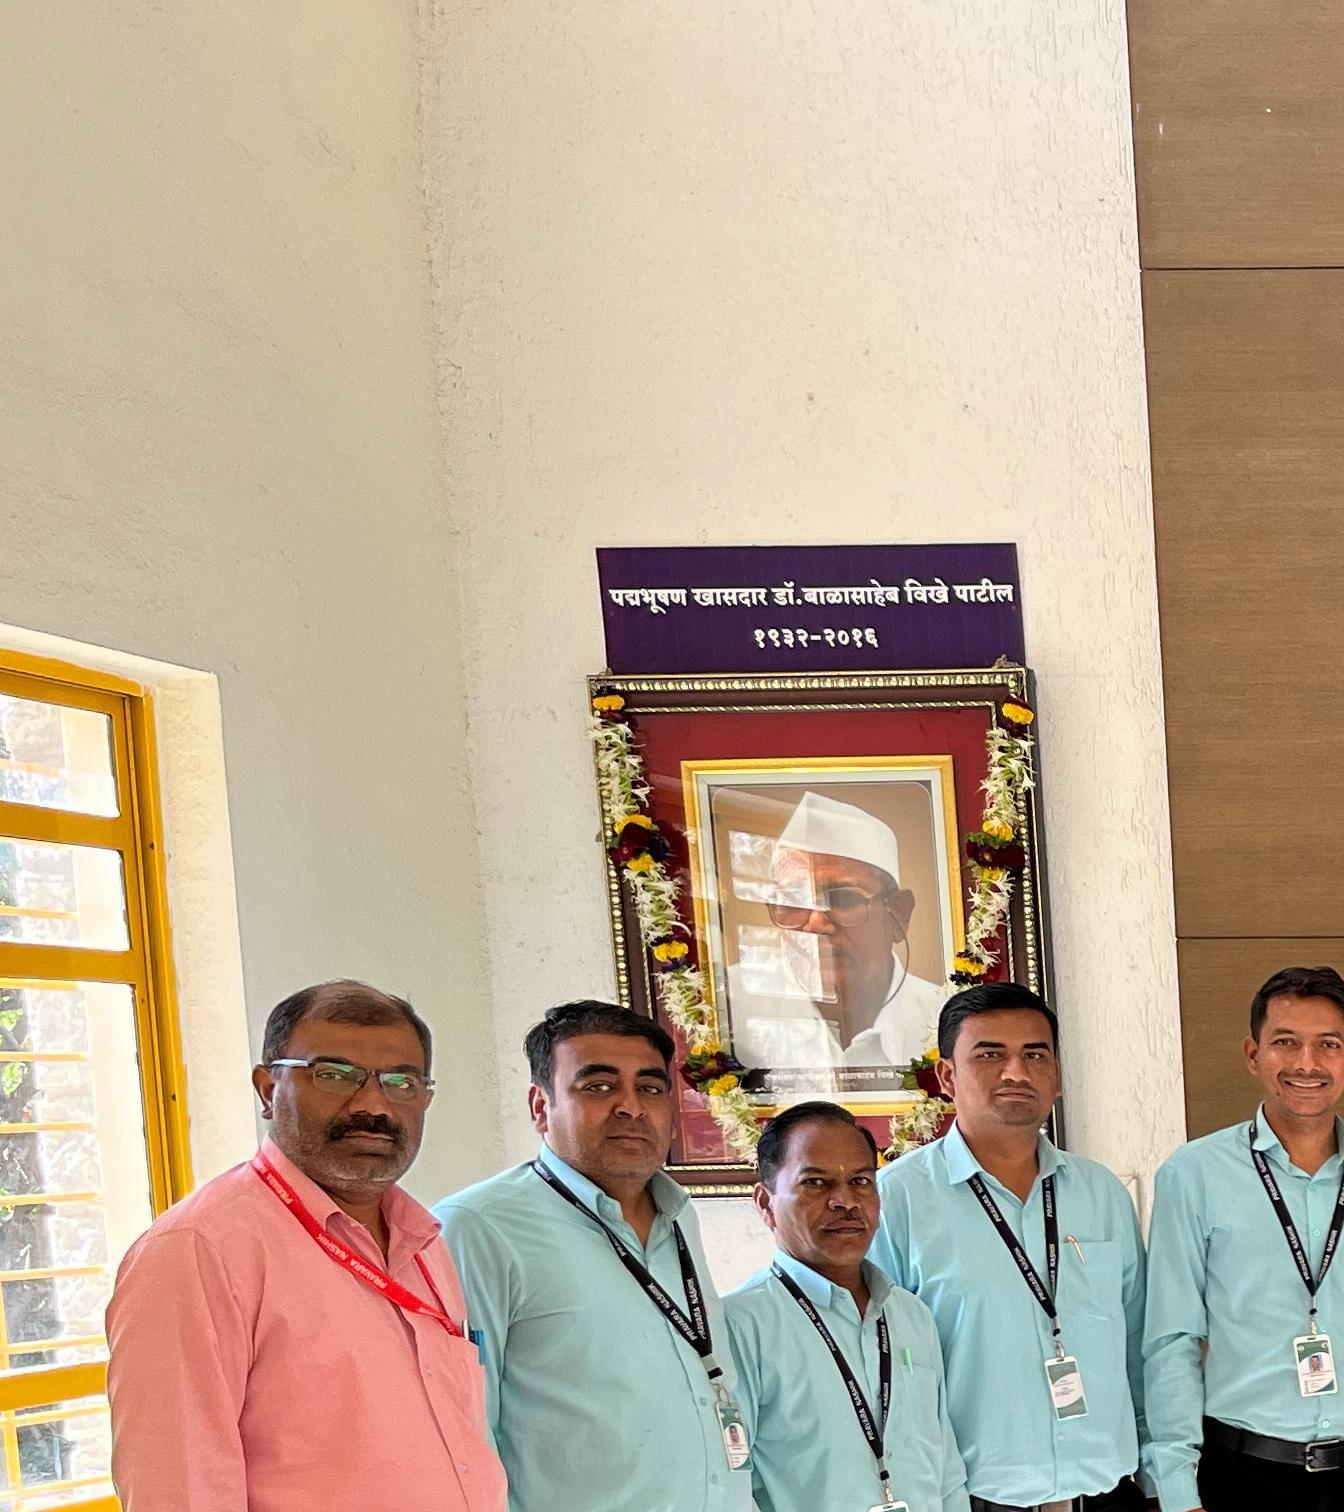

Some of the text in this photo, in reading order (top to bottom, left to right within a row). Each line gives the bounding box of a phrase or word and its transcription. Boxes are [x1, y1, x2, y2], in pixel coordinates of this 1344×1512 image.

[608, 577, 1014, 615] पद्मभूषण खासदार डॉ.बाळासाहेब विखे पाटील
[754, 627, 879, 649] १९३२-२०१६
[317, 1234, 387, 1288] PRAVARA NASHIK
[648, 1283, 697, 1340] PRAVARA NASHIK
